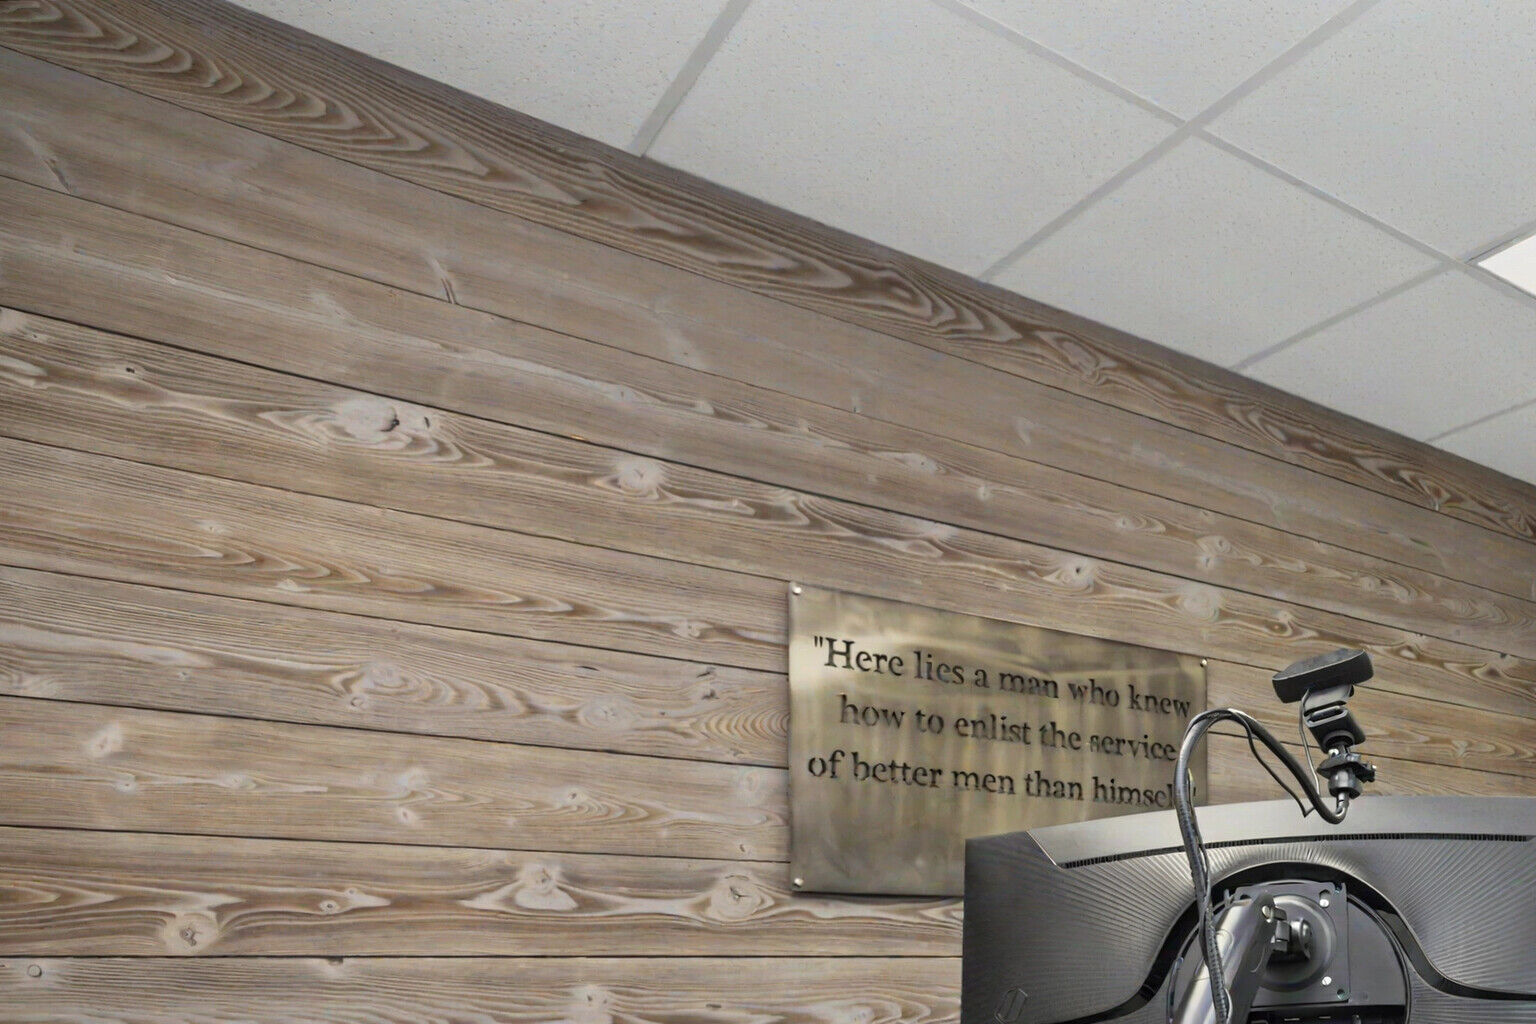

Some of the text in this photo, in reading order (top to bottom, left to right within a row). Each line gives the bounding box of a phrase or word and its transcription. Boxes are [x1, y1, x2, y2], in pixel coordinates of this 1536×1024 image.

[813, 635, 1191, 718] "Here lies a man who knew
[838, 693, 1178, 762] how to enlist the service
[807, 749, 846, 779] of
[850, 751, 943, 789] better
[951, 769, 1016, 796] men
[1024, 770, 1084, 801] than
